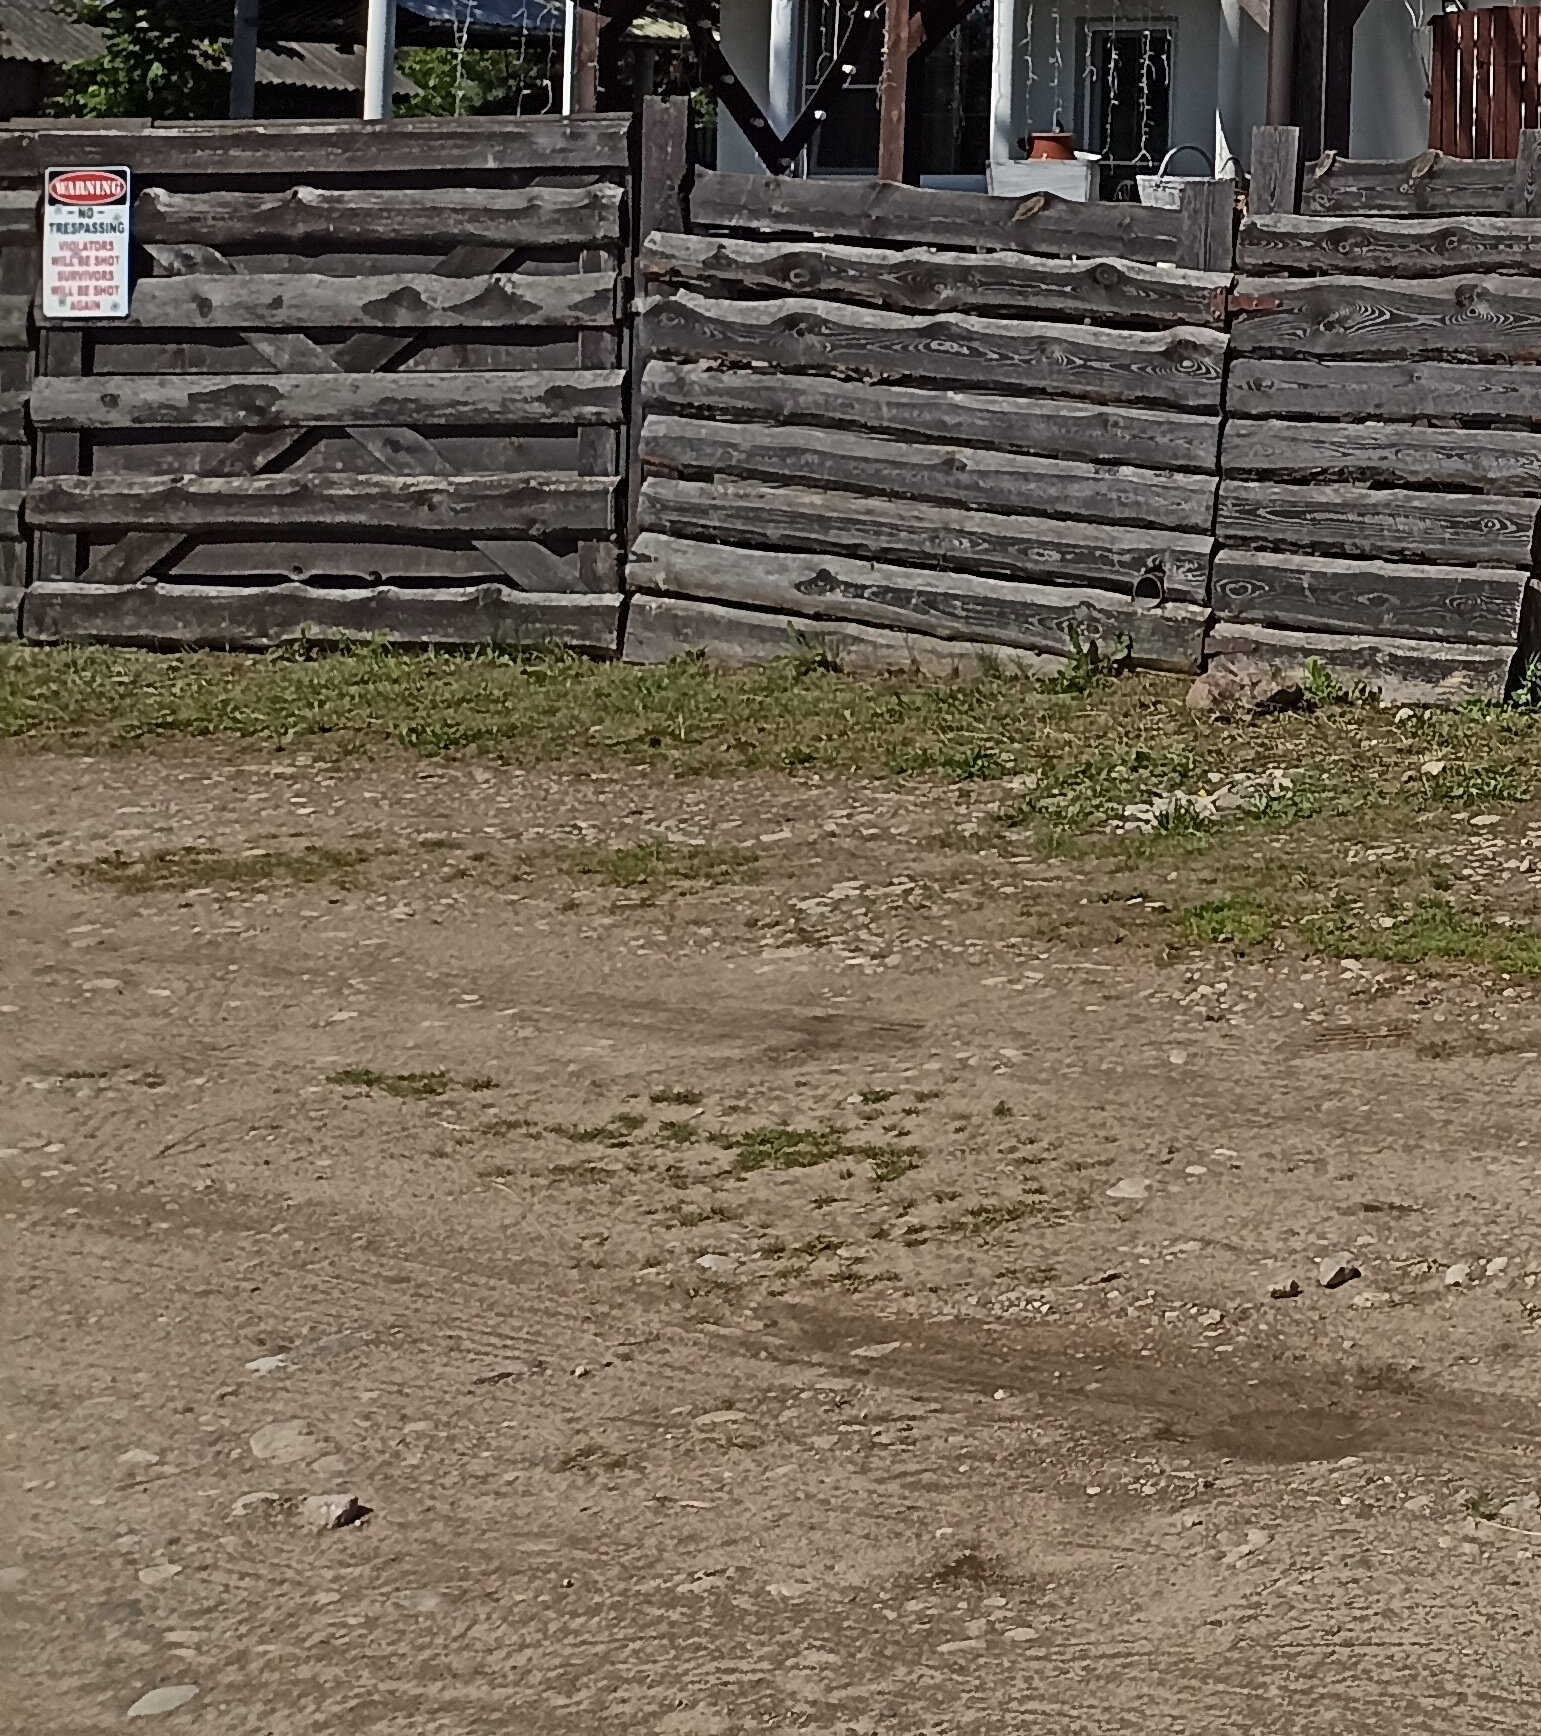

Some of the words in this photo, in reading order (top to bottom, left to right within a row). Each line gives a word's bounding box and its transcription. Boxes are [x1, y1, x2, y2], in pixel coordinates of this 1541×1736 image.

[55, 180, 121, 195] WARNING
[78, 207, 94, 219] NO
[49, 222, 125, 234] TRESPASSING
[59, 240, 114, 252] VIOLATORS
[51, 255, 74, 267] WILL
[78, 255, 91, 267] BE
[94, 255, 120, 266] SHOT
[57, 270, 114, 282] SURVIVORS
[51, 285, 73, 296] WILL
[77, 285, 90, 296] BE
[93, 285, 120, 296] SHOT
[70, 300, 101, 311] AGAIN
